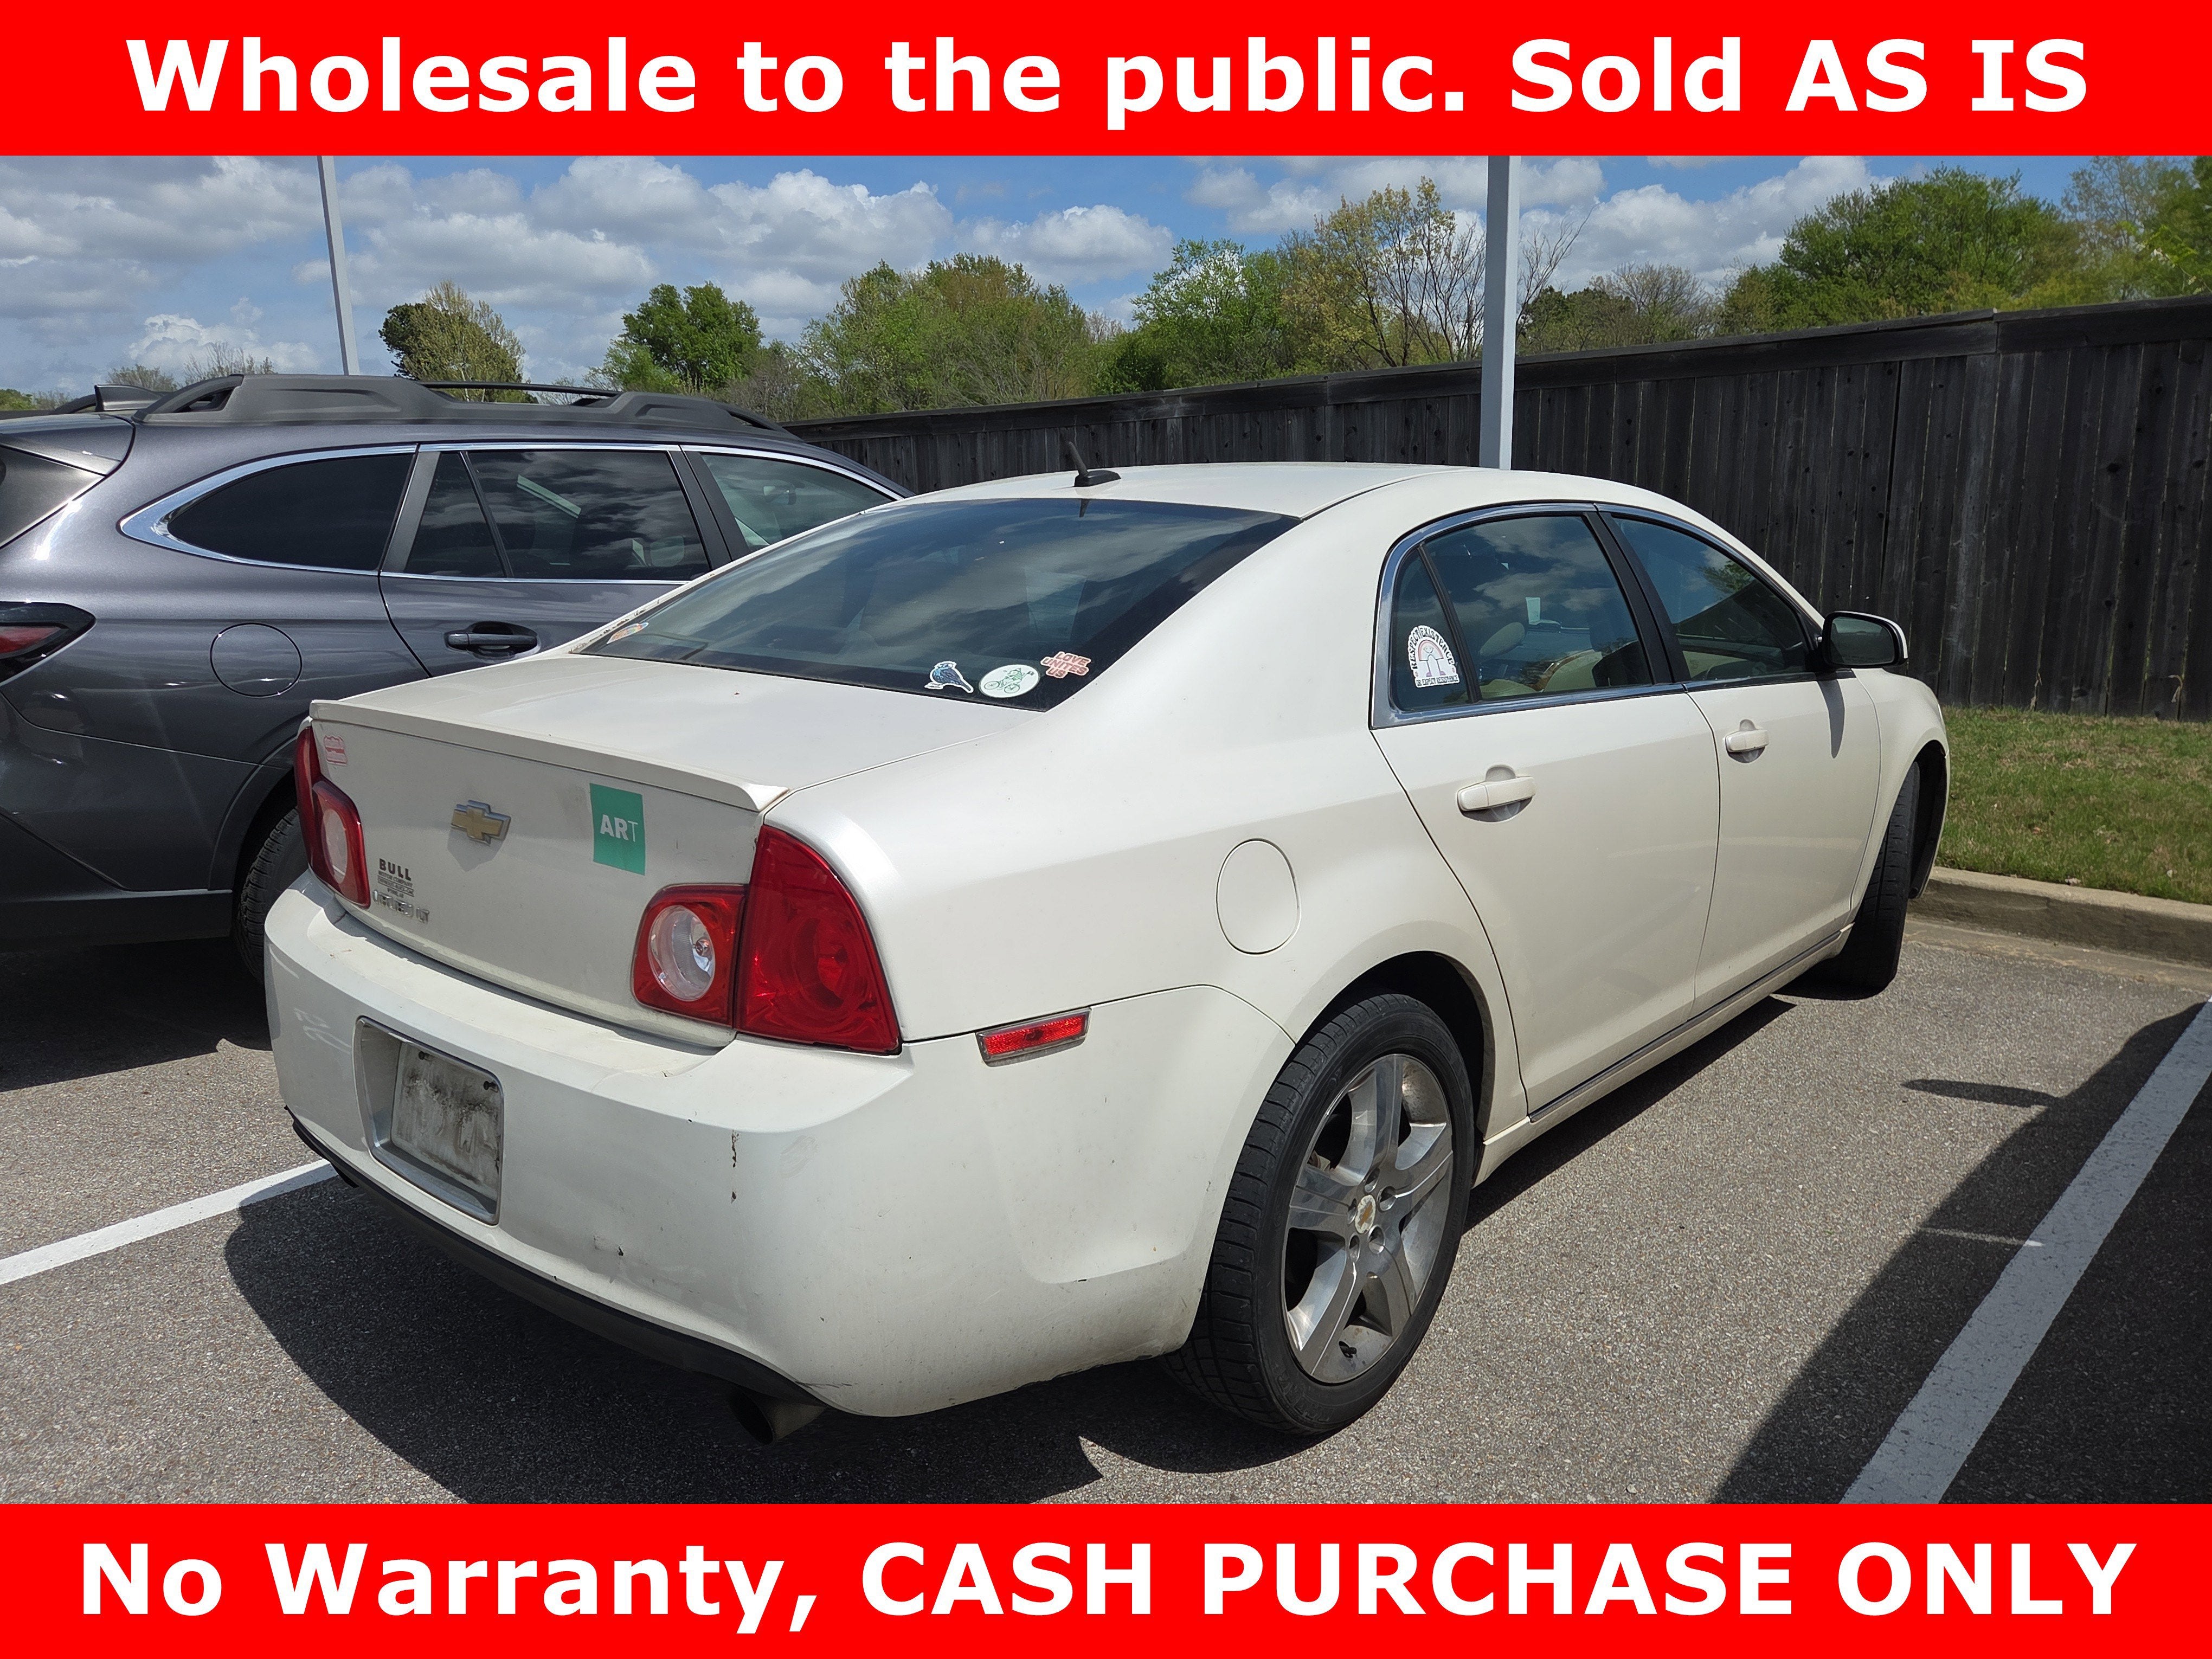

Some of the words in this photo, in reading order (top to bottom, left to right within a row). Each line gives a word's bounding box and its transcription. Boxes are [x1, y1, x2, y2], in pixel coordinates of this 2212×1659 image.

[1420, 627, 1454, 665] EXISTENCE
[1043, 658, 1087, 674] UNITES
[1056, 653, 1089, 666] LOVE
[1048, 667, 1066, 677] US
[600, 814, 639, 843] ART
[379, 858, 411, 881] BULL
